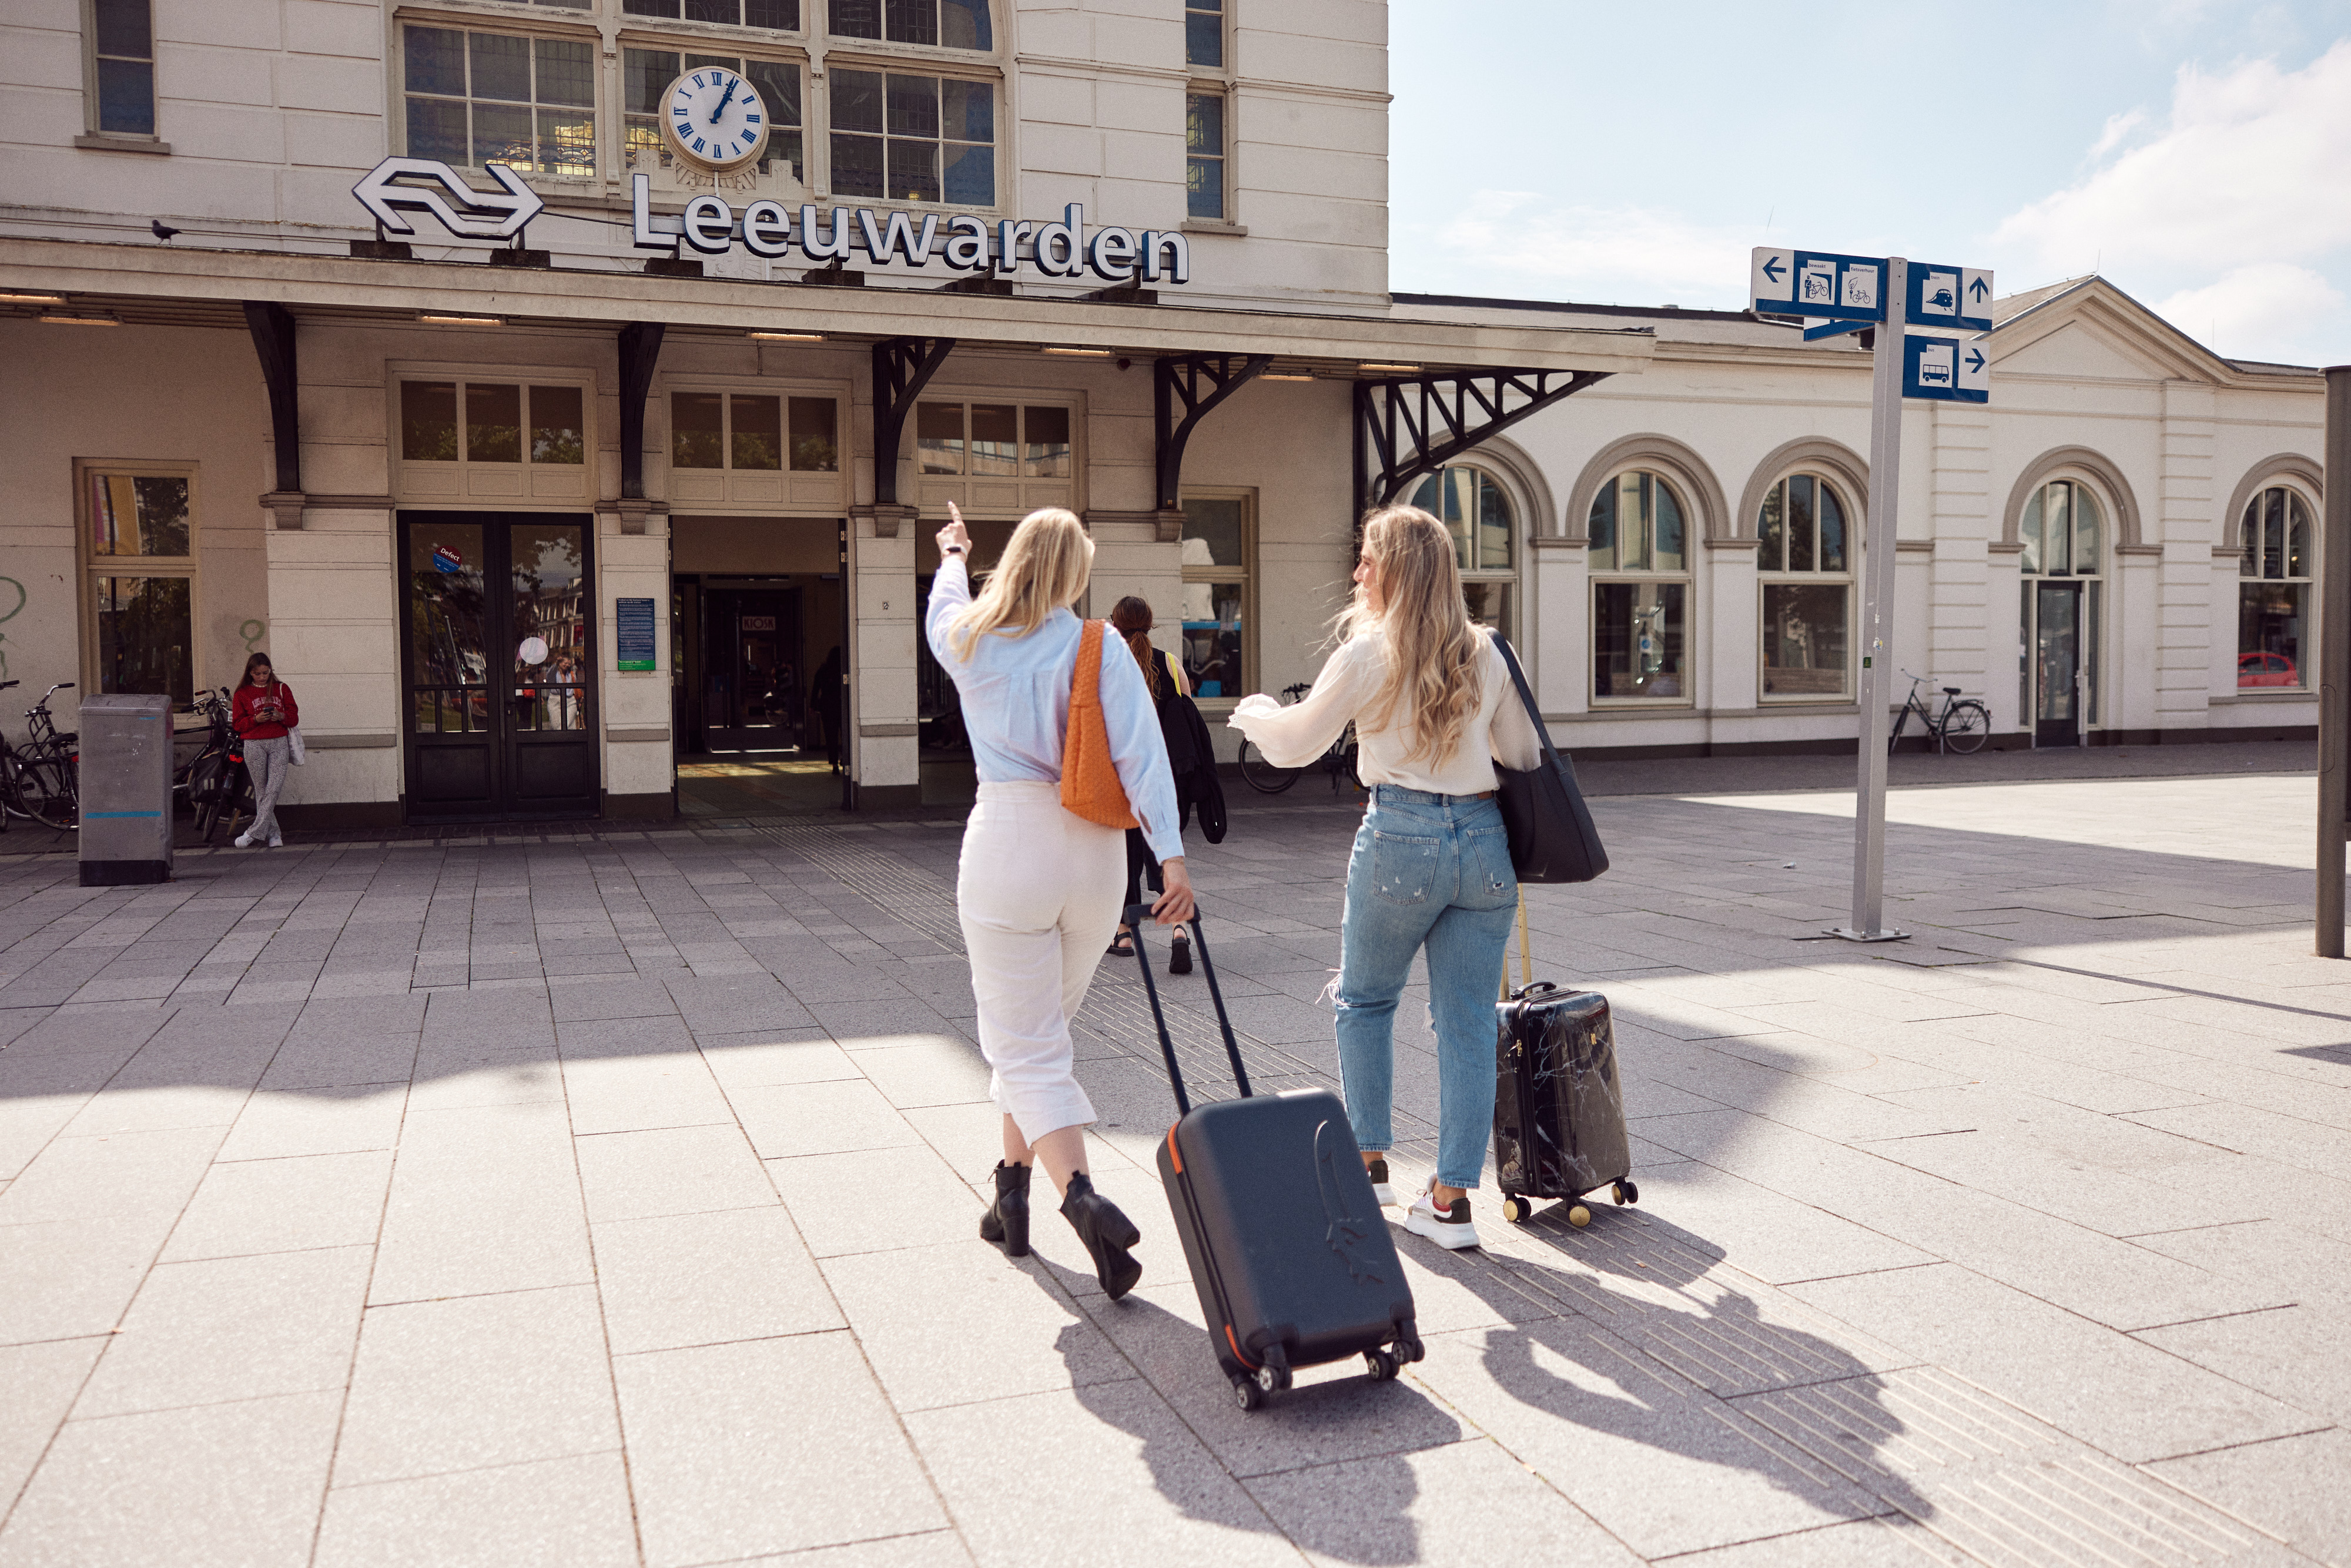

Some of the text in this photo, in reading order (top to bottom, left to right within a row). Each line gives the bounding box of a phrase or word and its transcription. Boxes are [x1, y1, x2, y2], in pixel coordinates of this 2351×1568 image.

[631, 173, 1190, 284] Leeuwarden
[440, 547, 460, 562] Defect
[744, 618, 774, 629] KIOSK
